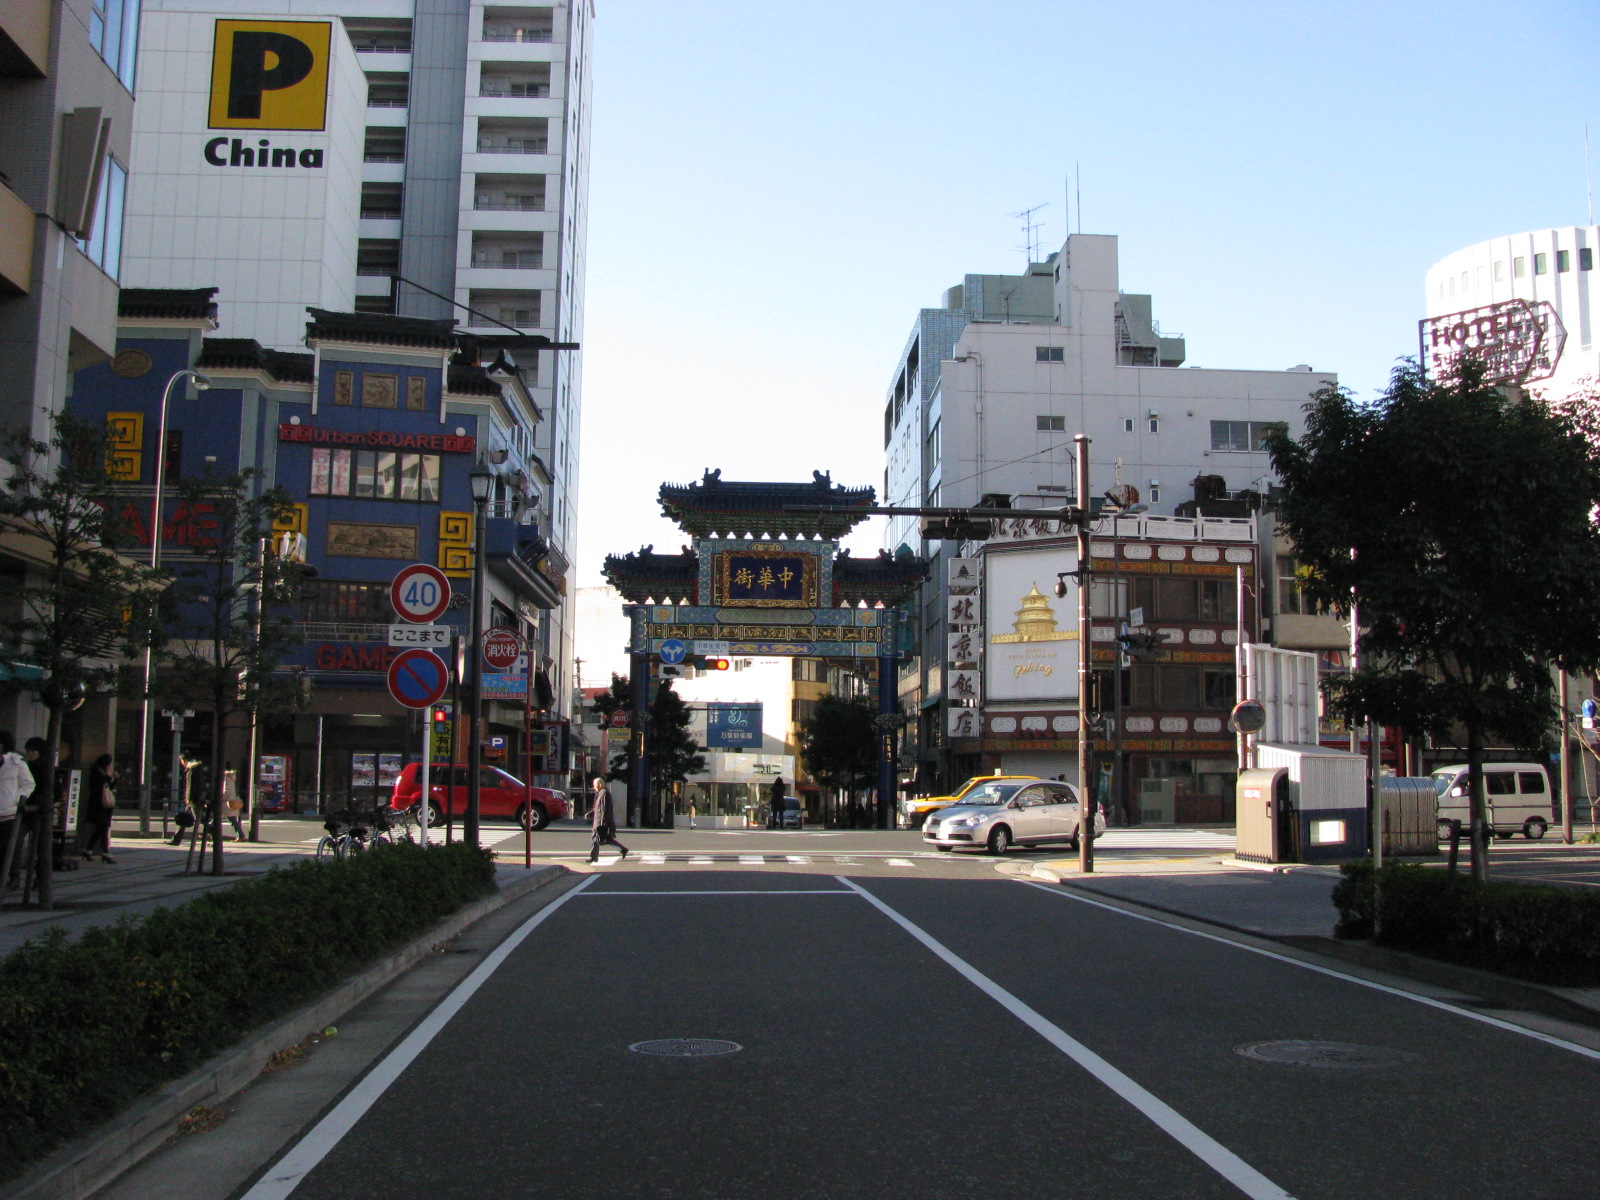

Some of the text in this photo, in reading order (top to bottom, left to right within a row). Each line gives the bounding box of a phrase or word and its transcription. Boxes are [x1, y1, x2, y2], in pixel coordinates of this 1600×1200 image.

[228, 30, 313, 119] P
[205, 137, 323, 168] China
[1431, 312, 1522, 348] HOTEL
[314, 427, 443, 450] Urban SQUARE
[405, 581, 436, 607] 40
[393, 629, 445, 642] ここまで
[316, 643, 400, 671] GAME
[487, 643, 517, 657] 消火栓
[952, 598, 976, 733] 北京飯店
[1014, 661, 1053, 678] Peking
[492, 738, 503, 747] P
